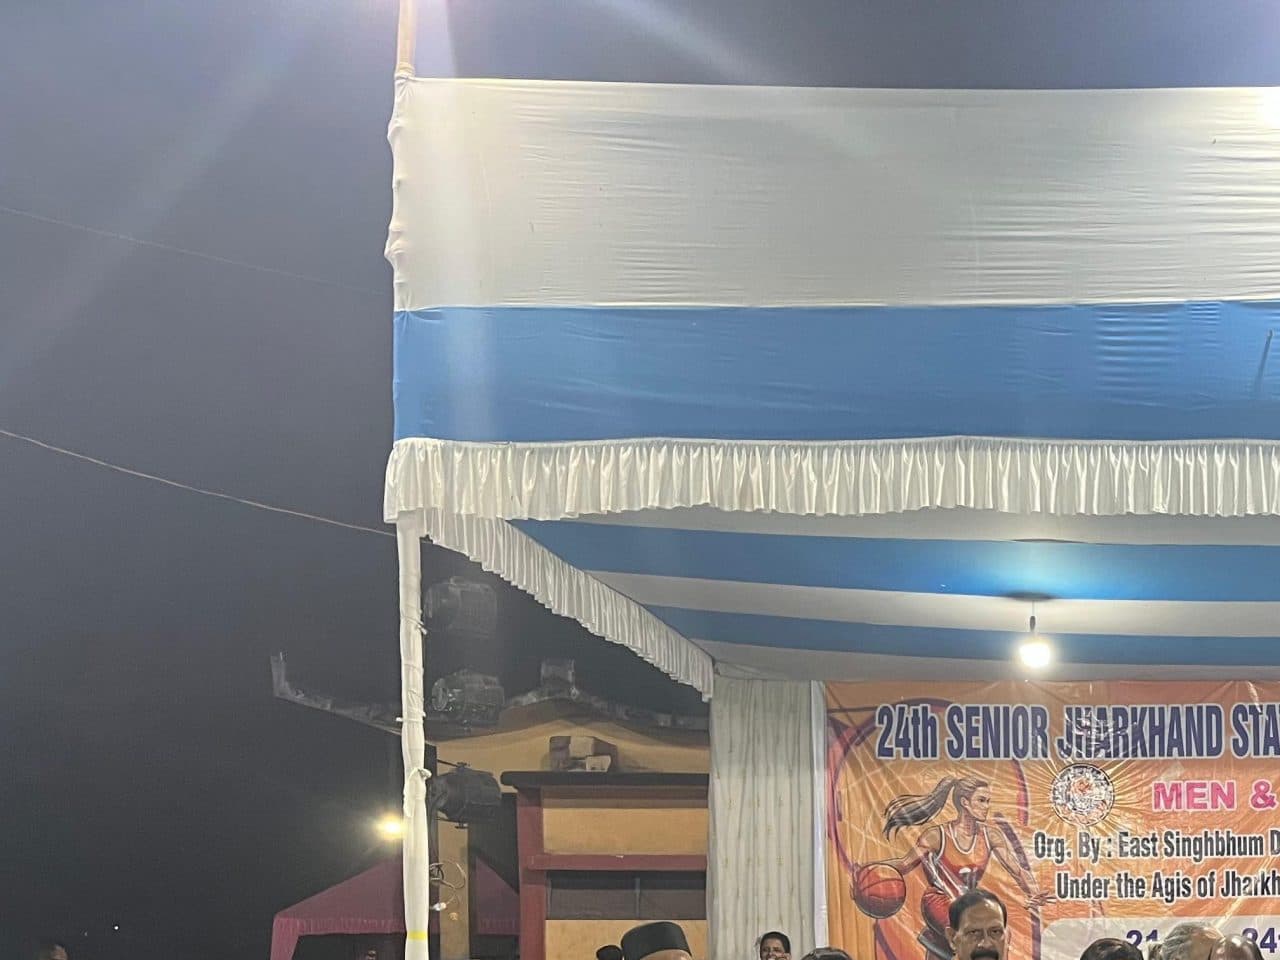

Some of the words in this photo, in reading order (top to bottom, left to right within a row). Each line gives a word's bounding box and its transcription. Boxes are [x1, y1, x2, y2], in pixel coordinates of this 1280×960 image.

[875, 704, 939, 759] 24th
[946, 704, 1049, 759] SENIOR
[1056, 703, 1223, 759] JHARKHAND
[1152, 781, 1236, 810] MEN
[1249, 780, 1277, 810] &
[1034, 831, 1072, 863] Org.
[1078, 831, 1101, 863] By
[1118, 831, 1159, 858] East
[1164, 829, 1265, 862] Singhbhum
[1056, 872, 1110, 899] Under
[1116, 872, 1146, 897] the
[1152, 871, 1192, 904] Agis
[1197, 871, 1216, 897] of
